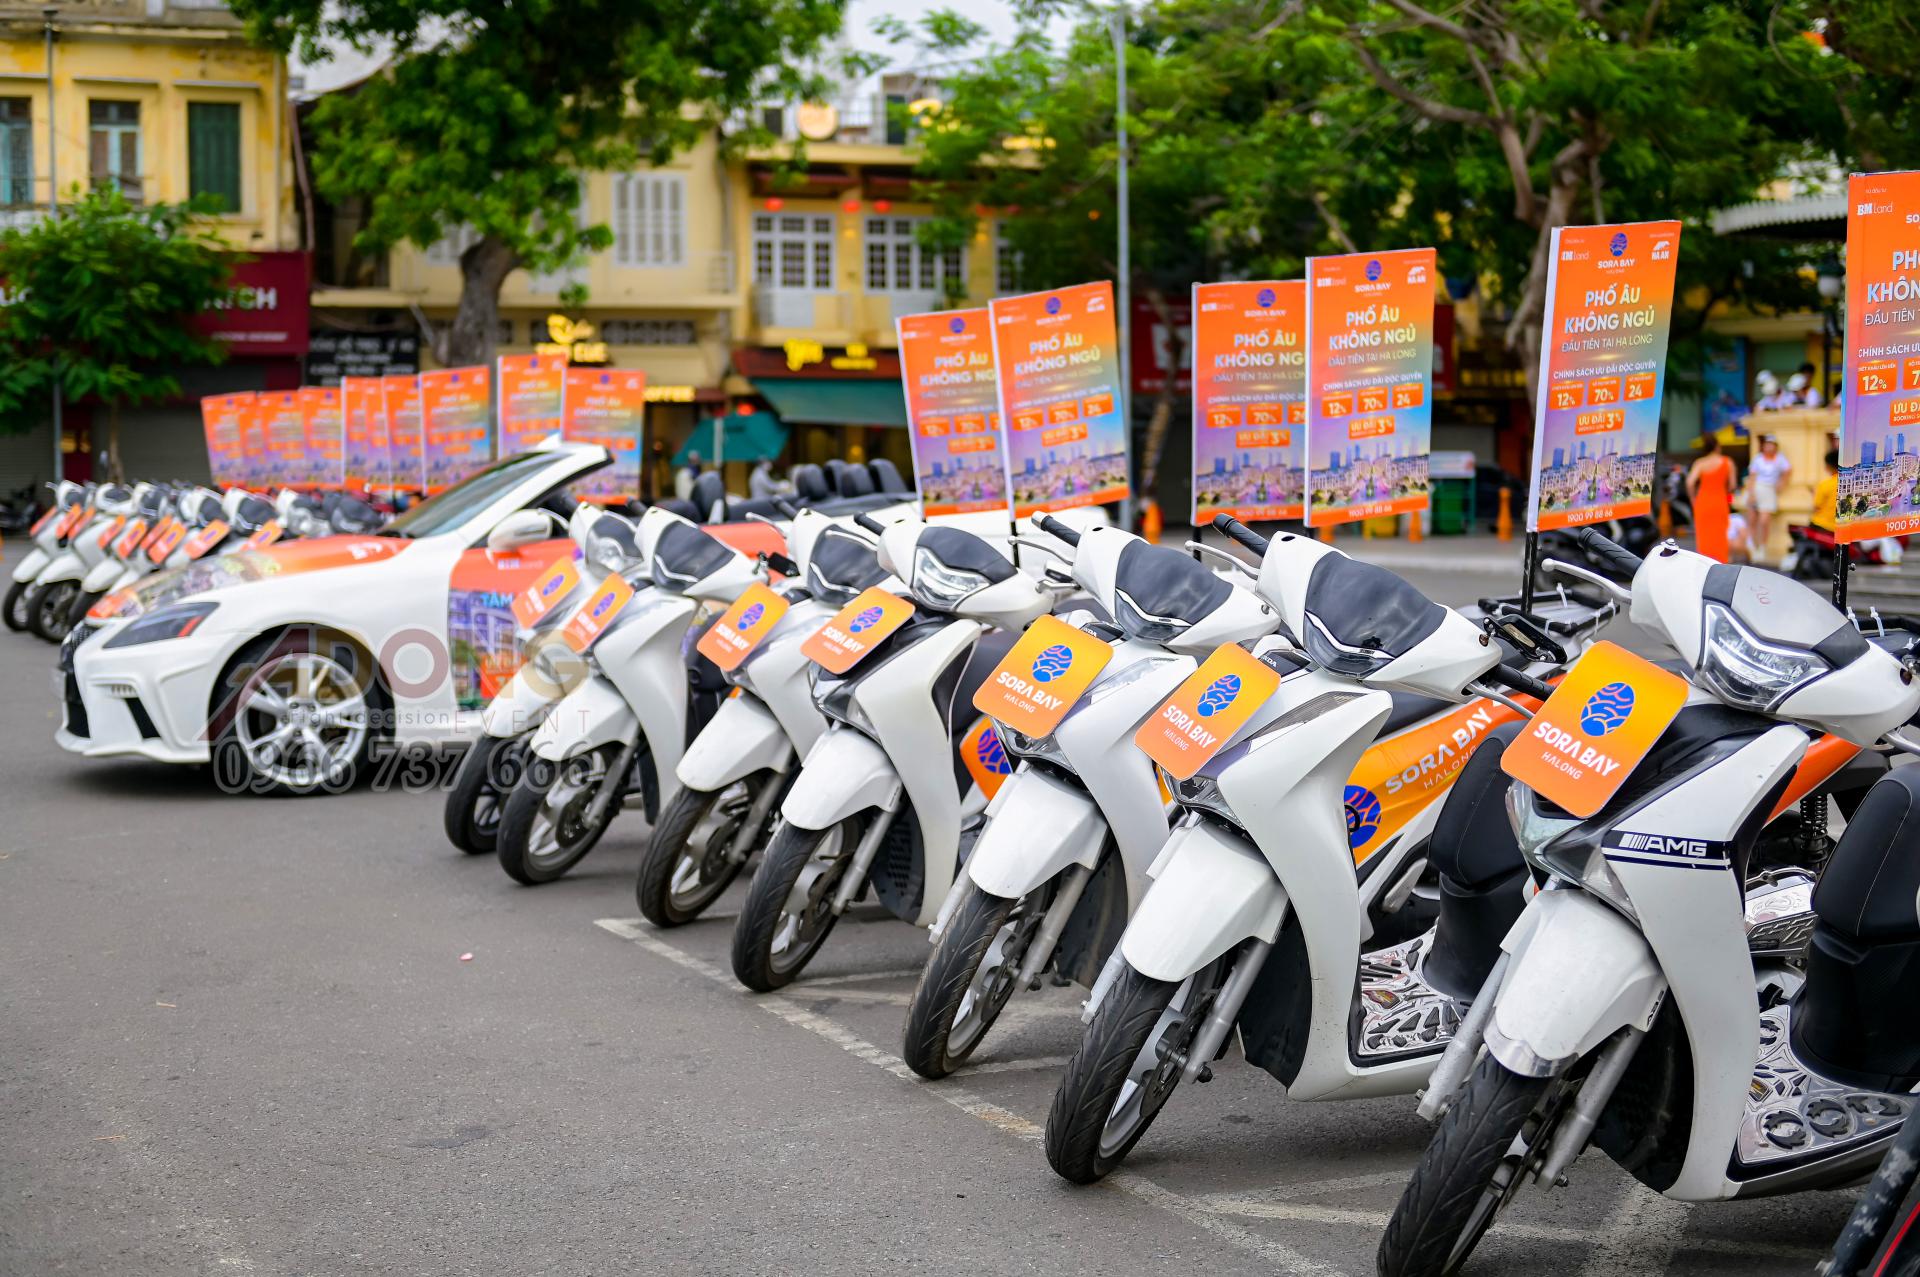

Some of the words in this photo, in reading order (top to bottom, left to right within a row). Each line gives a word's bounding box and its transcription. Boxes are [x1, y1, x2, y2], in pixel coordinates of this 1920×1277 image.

[1906, 213, 1920, 224] SO
[1892, 249, 1920, 271] PH
[1584, 283, 1617, 308] PHỐ
[1619, 284, 1641, 305] ÂU
[1346, 304, 1377, 327] PHỐ
[1379, 304, 1399, 324] ÂU
[1564, 310, 1620, 334] KHÔNG
[1622, 304, 1656, 328] NGỦ
[1891, 307, 1915, 323] TIÊN
[1029, 333, 1060, 354] PHỐ
[1063, 332, 1083, 349] ÂU
[1234, 328, 1270, 348] PHỐ
[1273, 328, 1297, 346] ÂU
[1329, 329, 1381, 350] KHÔNG
[1215, 349, 1276, 368] KHÔNG
[1279, 351, 1305, 366] NG
[1858, 346, 1884, 358] CHÍNH
[1886, 343, 1910, 355] SÁCH
[975, 368, 995, 381] NG
[1014, 355, 1066, 375] KHÔNG
[1627, 385, 1642, 399] 24
[1862, 374, 1887, 391] 12%
[1556, 393, 1576, 407] 12%
[1594, 388, 1614, 402] 70%
[1886, 521, 1906, 532] 1900
[1909, 518, 1920, 529] 99
[996, 671, 1034, 699] SORA
[1032, 688, 1063, 712] BAY
[1003, 692, 1037, 714] HALONG
[1162, 704, 1191, 735] SORA
[1188, 721, 1217, 749] BAY
[1163, 728, 1190, 752] HALONG
[1533, 721, 1580, 756] SORA
[1576, 747, 1621, 777] BAY
[1385, 744, 1447, 795] SORA
[1452, 706, 1493, 750] BAY
[1541, 751, 1583, 780] HALONG
[1643, 838, 1708, 857] AMG
